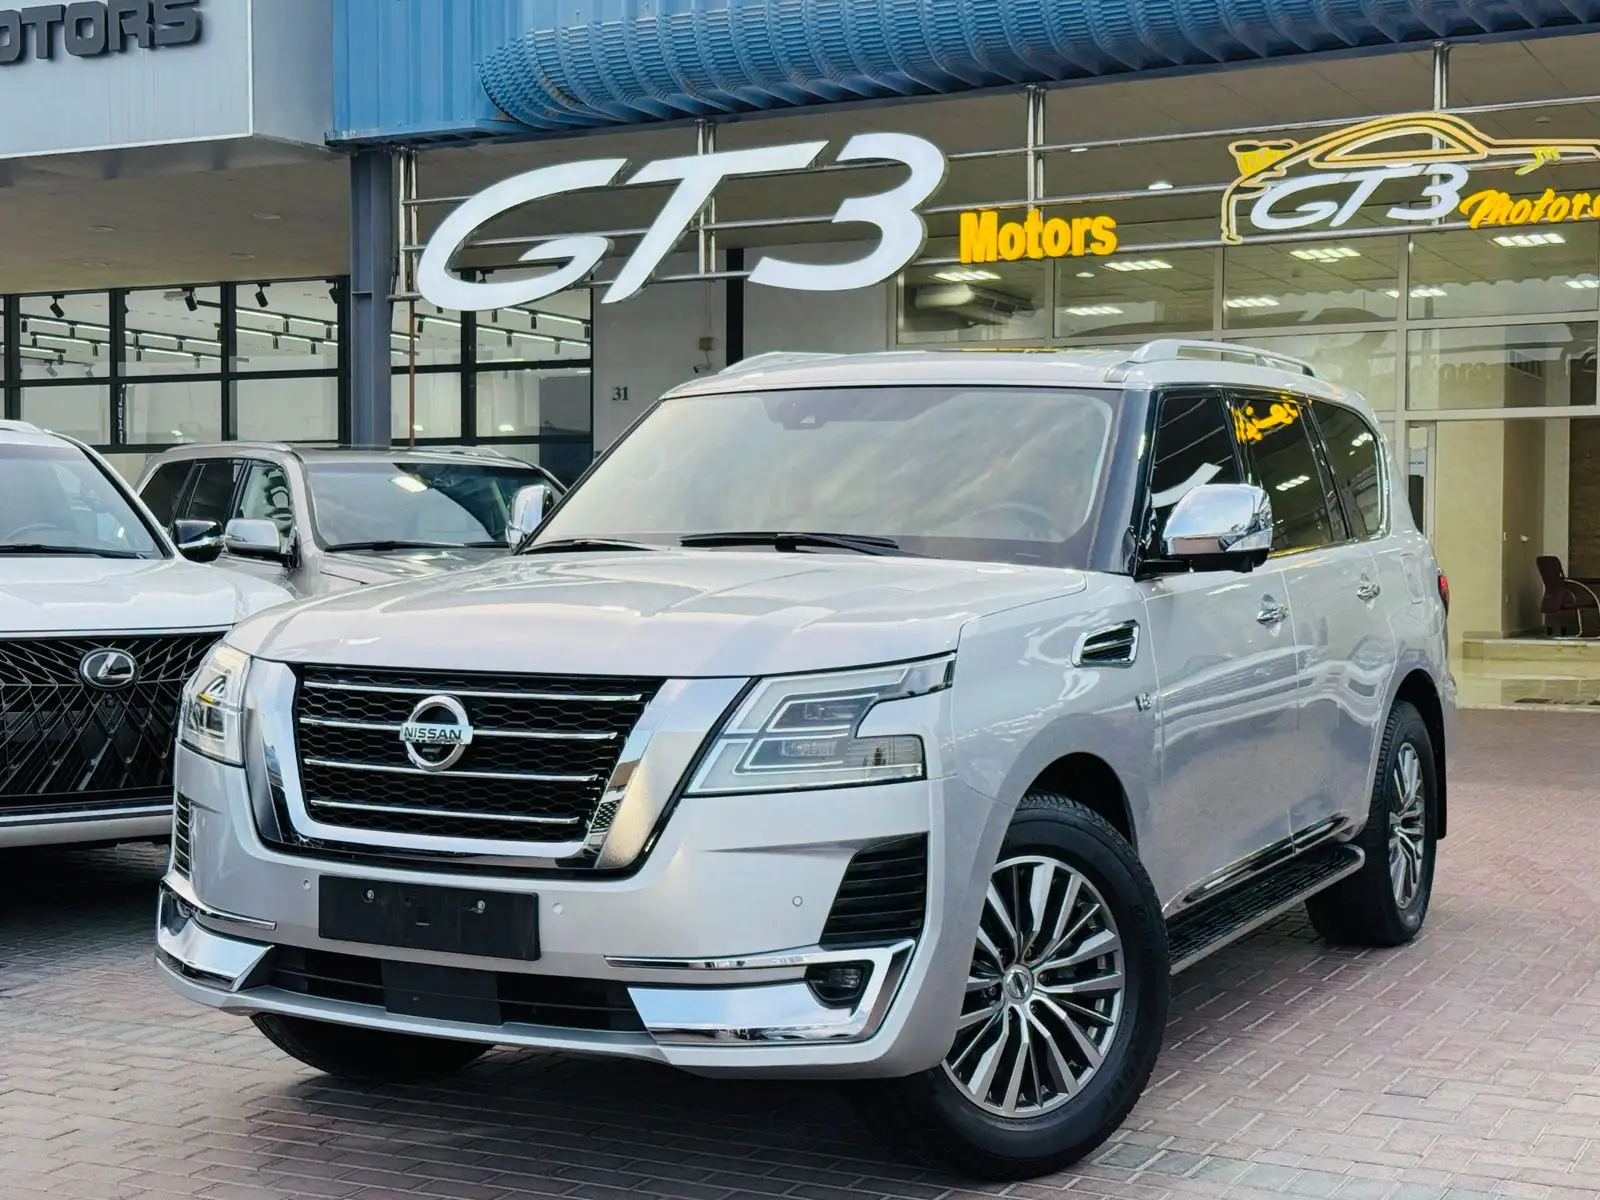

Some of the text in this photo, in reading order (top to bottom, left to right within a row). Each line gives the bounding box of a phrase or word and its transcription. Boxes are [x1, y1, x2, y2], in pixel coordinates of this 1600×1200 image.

[960, 208, 1118, 263] Motors
[612, 386, 629, 401] 31
[404, 726, 462, 740] NISSAN
